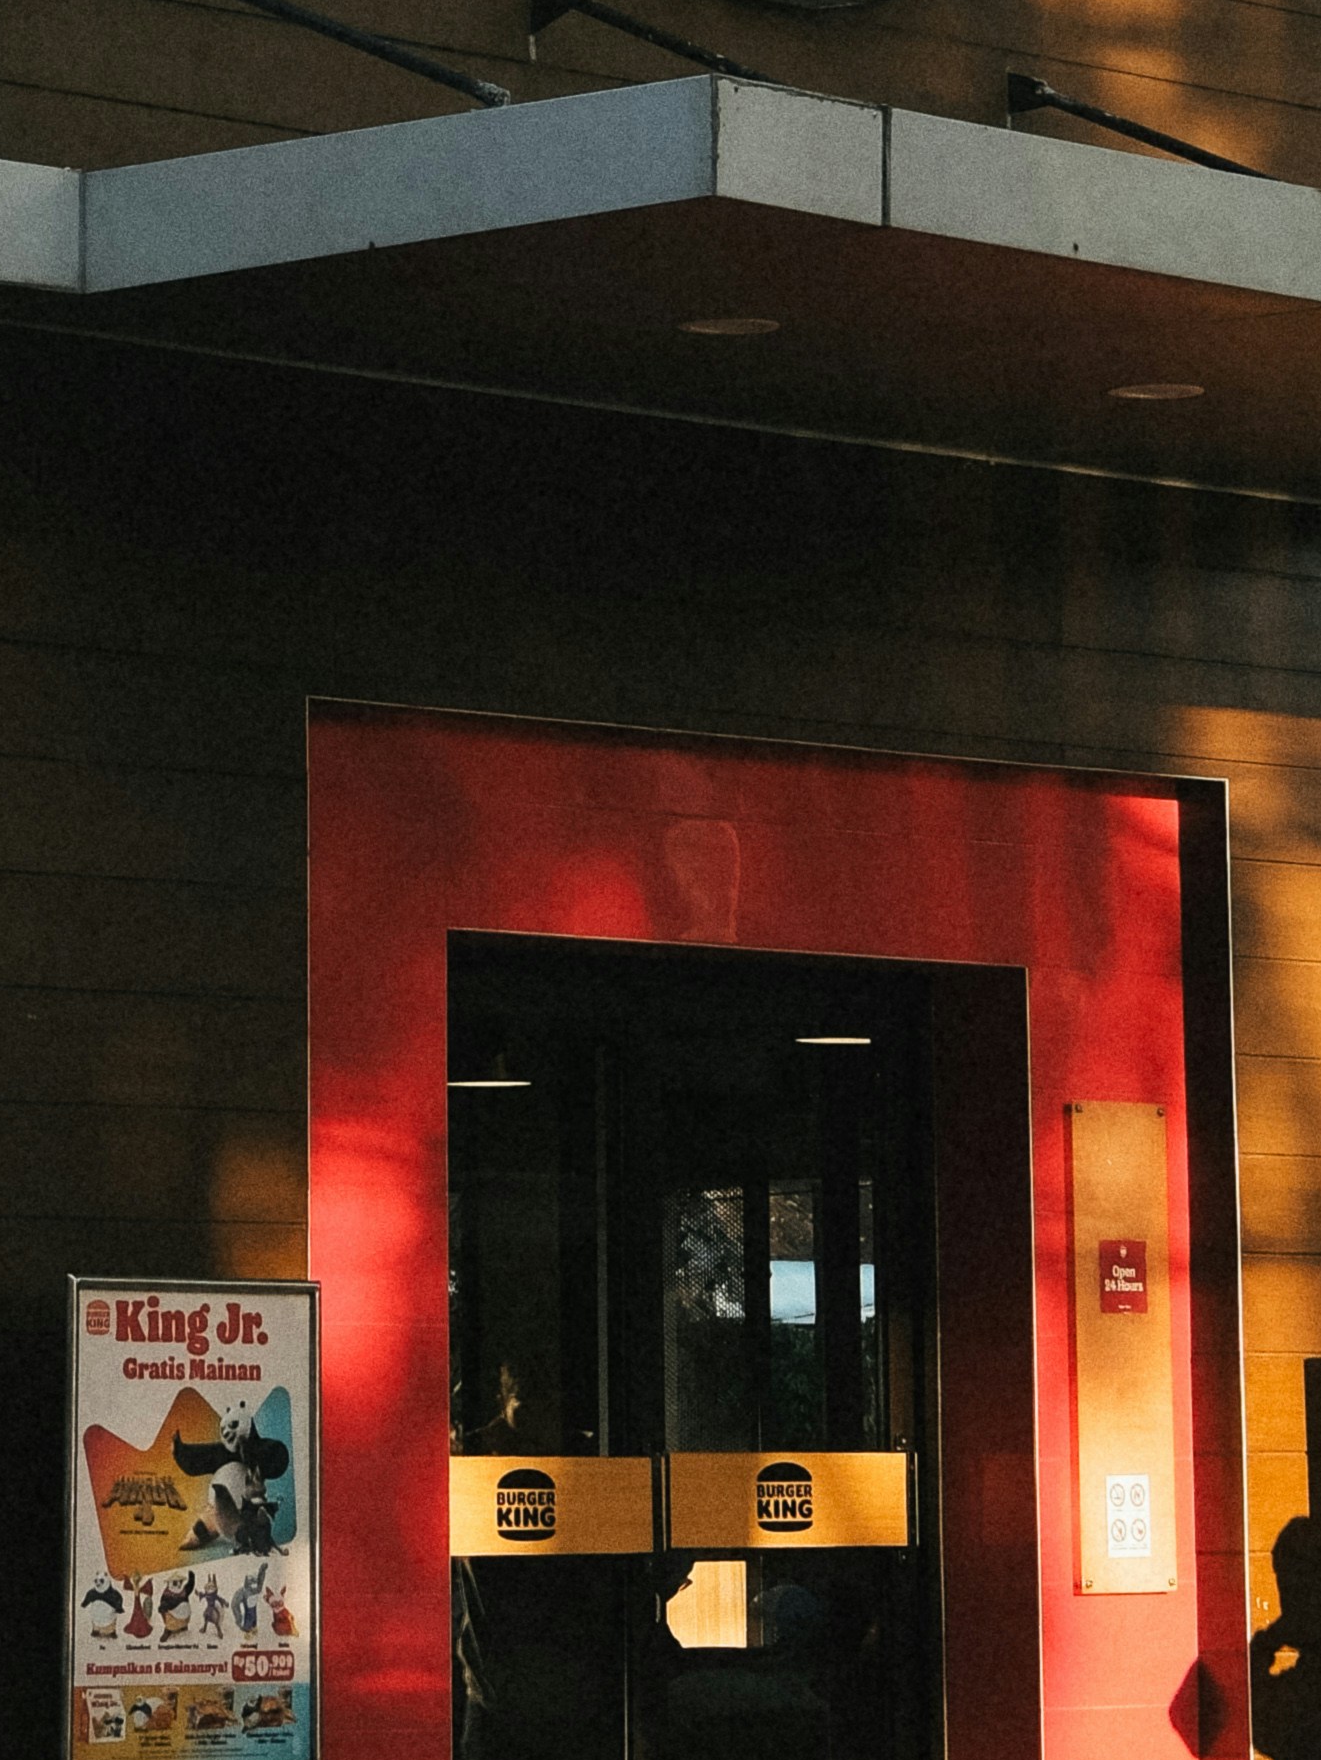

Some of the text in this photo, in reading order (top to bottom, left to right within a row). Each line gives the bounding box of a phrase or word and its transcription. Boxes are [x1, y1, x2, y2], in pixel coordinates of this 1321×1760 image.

[1112, 1264, 1136, 1279] Open
[1104, 1279, 1144, 1292] 24 Hours
[115, 1295, 269, 1356] King Jr.
[123, 1356, 262, 1381] Gratis Mainan
[496, 1491, 556, 1507] BURGER
[756, 1483, 813, 1499] BURGER
[496, 1506, 556, 1528] KING
[756, 1498, 813, 1520] KING
[86, 1662, 153, 1678] Kumpulkan
[154, 1662, 162, 1674] 6
